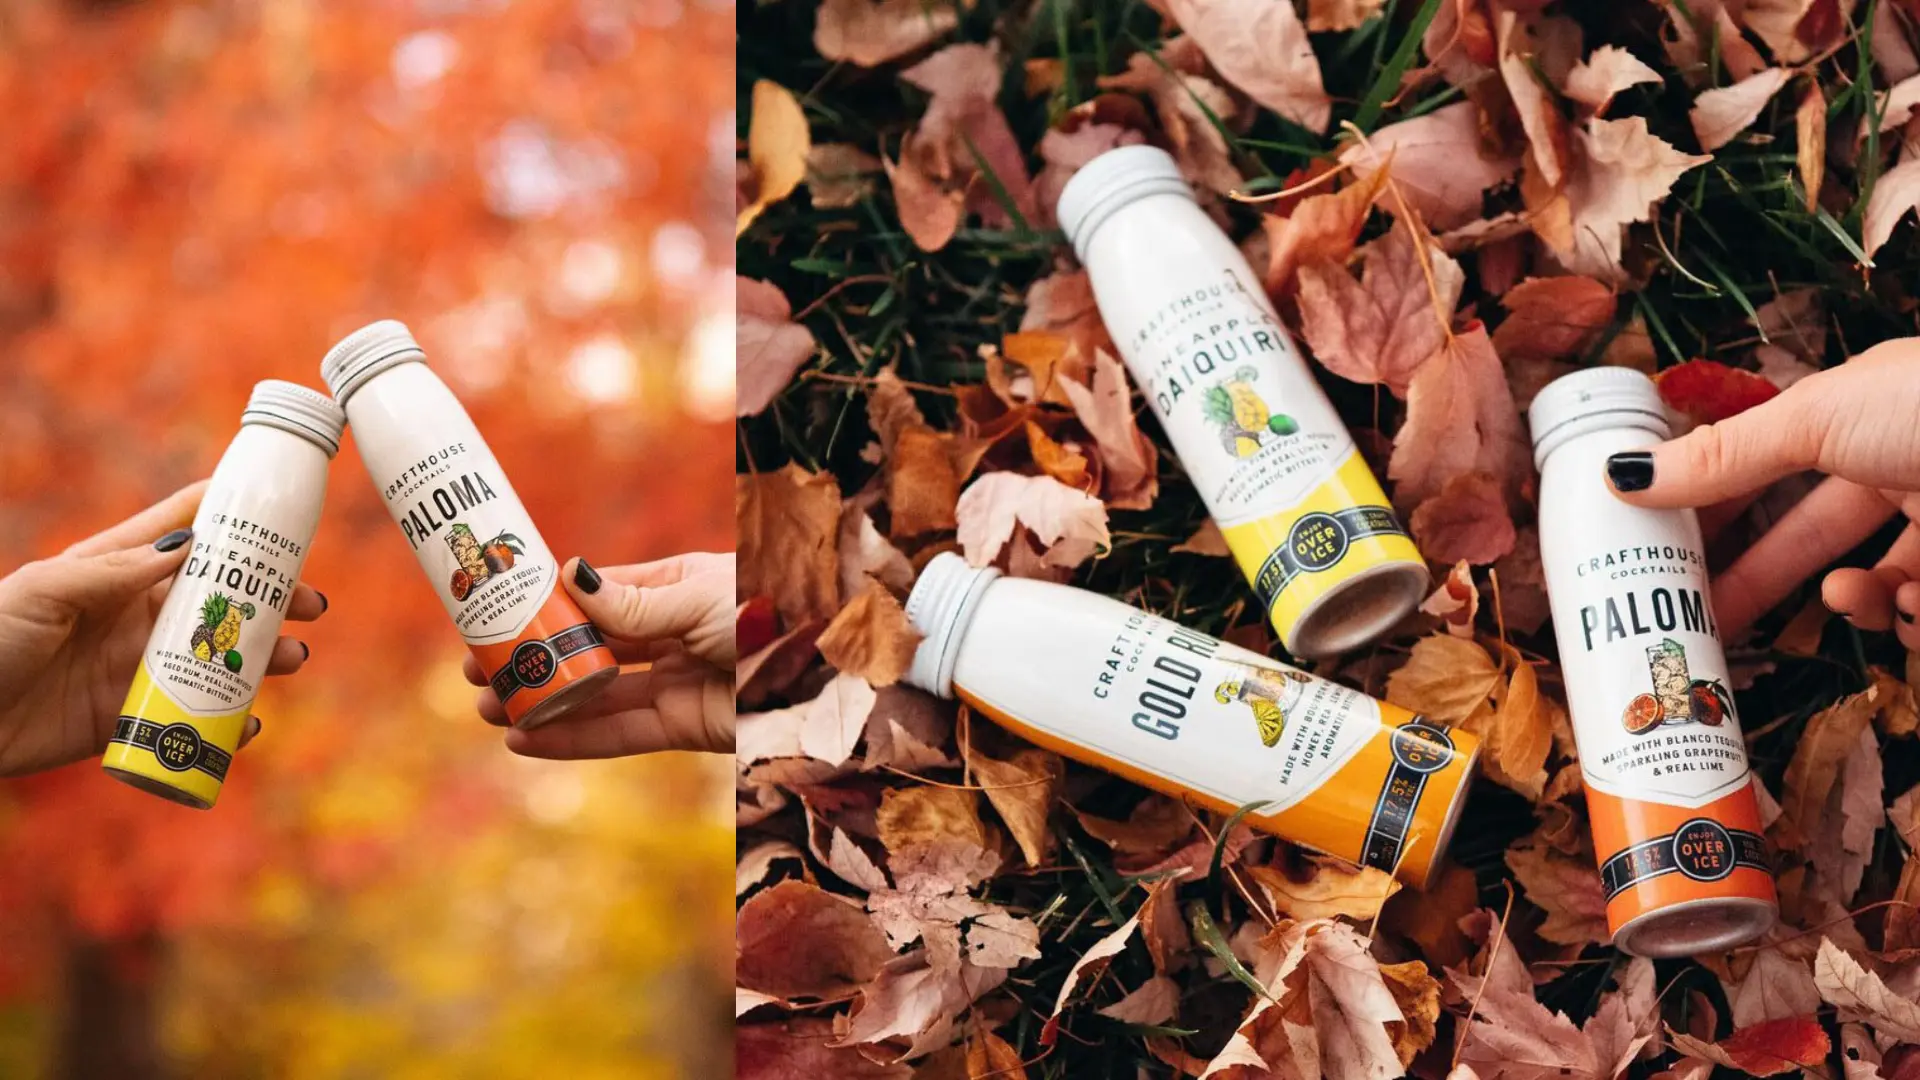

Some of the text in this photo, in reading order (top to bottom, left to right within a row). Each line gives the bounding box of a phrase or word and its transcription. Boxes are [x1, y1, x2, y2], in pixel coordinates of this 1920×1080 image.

[1157, 330, 1286, 417] DAIQUIRI
[384, 442, 467, 501] CRAFTHOUSE
[403, 463, 452, 498] COCKTAILS
[400, 471, 498, 551] PALOMA
[211, 513, 302, 558] CRAFTHOUSE
[228, 532, 281, 558] COCKTAILS
[1296, 527, 1337, 556] OVER
[1310, 542, 1336, 562] ICE
[185, 556, 288, 613] DAIQUIRI
[1610, 565, 1687, 580] COCKTAILS
[462, 576, 542, 630] SPARKLING GRAPEFRUIT
[465, 599, 481, 614] WITH
[480, 579, 511, 601] BLANCO
[487, 606, 508, 622] REAL
[508, 594, 528, 609] LIME
[163, 661, 181, 673] AGED
[204, 675, 222, 688] REAL
[223, 682, 237, 694] LIME
[174, 654, 193, 665] WITH
[194, 660, 233, 681] PINEAPPLE
[518, 651, 548, 675] OVER
[528, 664, 548, 681] ICE
[168, 674, 233, 704] AROMATIC BITTERS
[1131, 656, 1202, 741] GOLD
[1318, 706, 1332, 726] REA
[163, 737, 194, 755] OVER
[166, 750, 186, 763] ICE
[1279, 755, 1298, 786] MADE
[1291, 725, 1309, 752] WITH
[1408, 730, 1431, 763] OVR
[1602, 747, 1629, 766] MADE
[1632, 737, 1662, 753] WITH
[1666, 733, 1711, 746] BLANCO
[1616, 749, 1681, 774] SPARKLING
[1653, 761, 1725, 777] & REAL LIME
[1681, 840, 1726, 857] OVER
[1693, 855, 1721, 870] ICE
